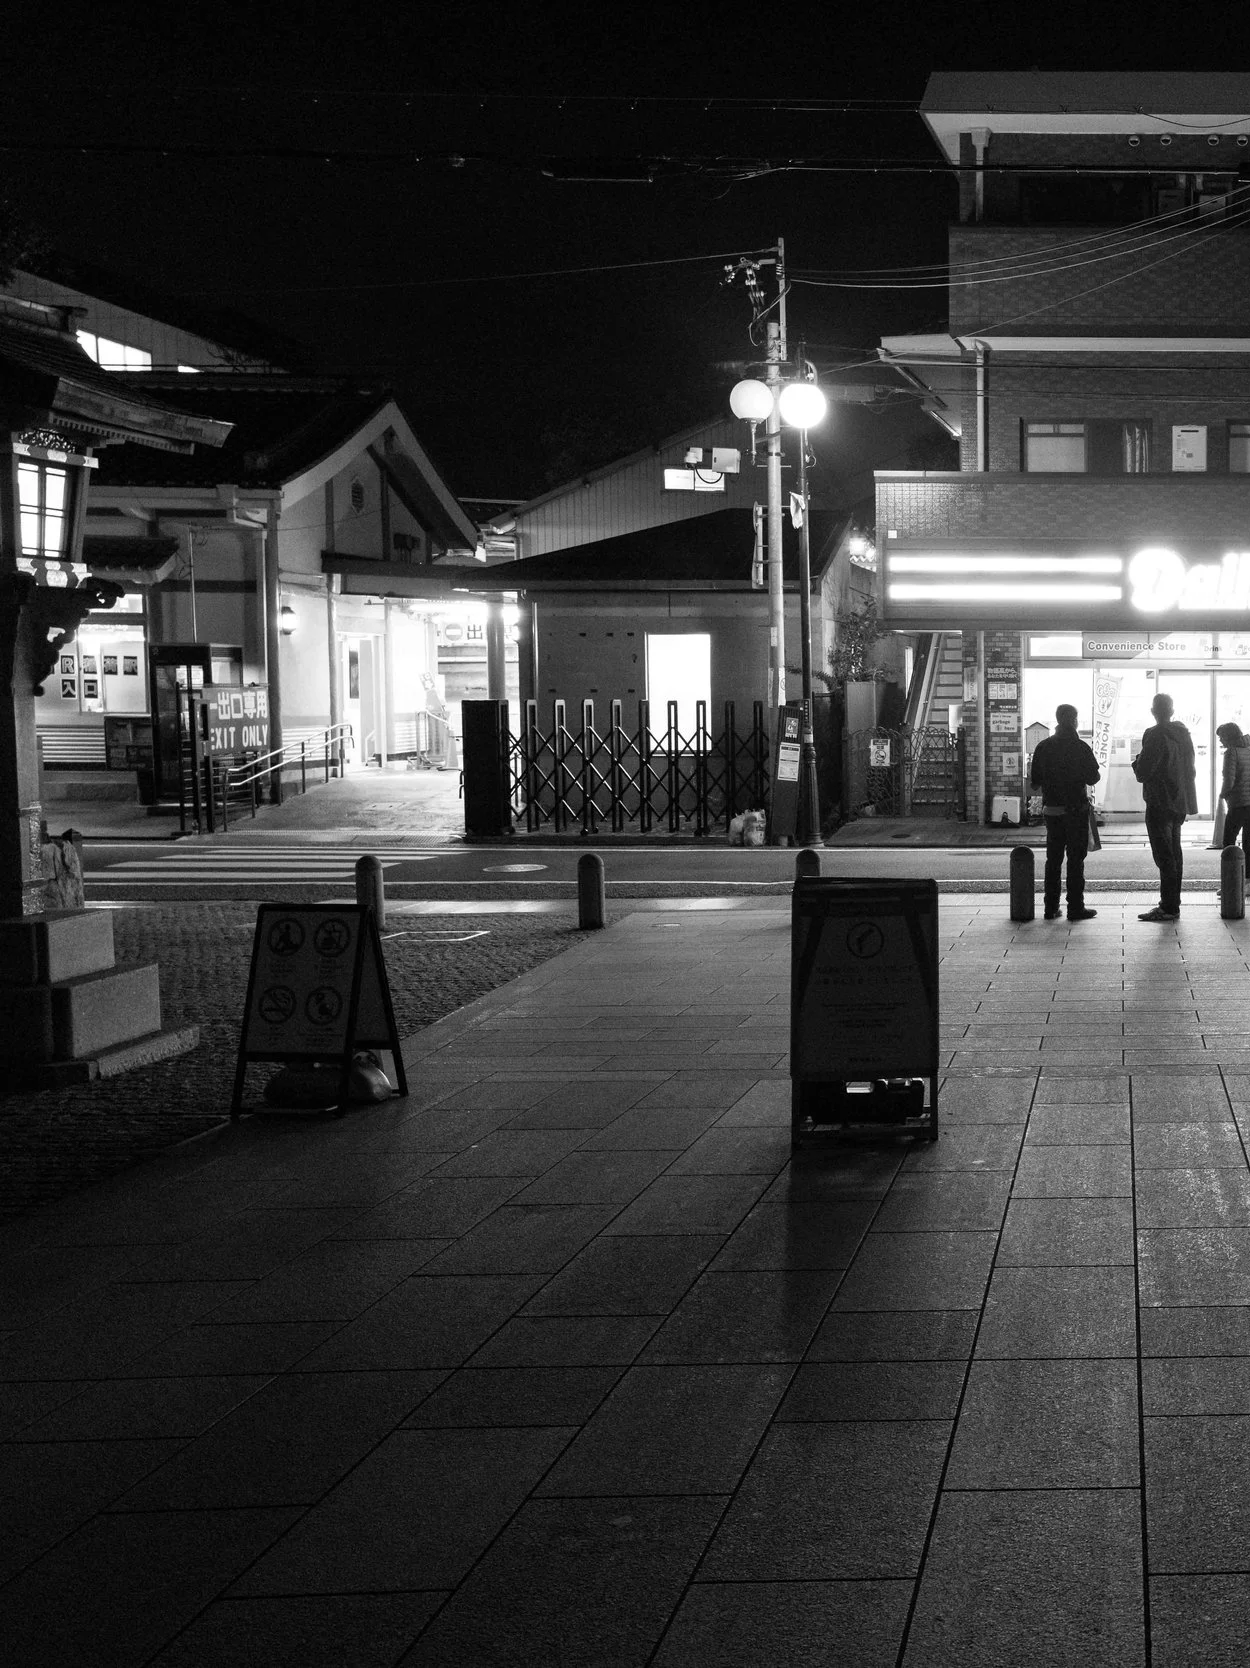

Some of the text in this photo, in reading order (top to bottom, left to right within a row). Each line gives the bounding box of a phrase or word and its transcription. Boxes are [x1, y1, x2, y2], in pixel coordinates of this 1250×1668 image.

[1087, 641, 1187, 651] Convenience Store
[62, 681, 98, 696] 入口
[242, 724, 268, 748] ONLY
[1099, 722, 1110, 768] MONEY
